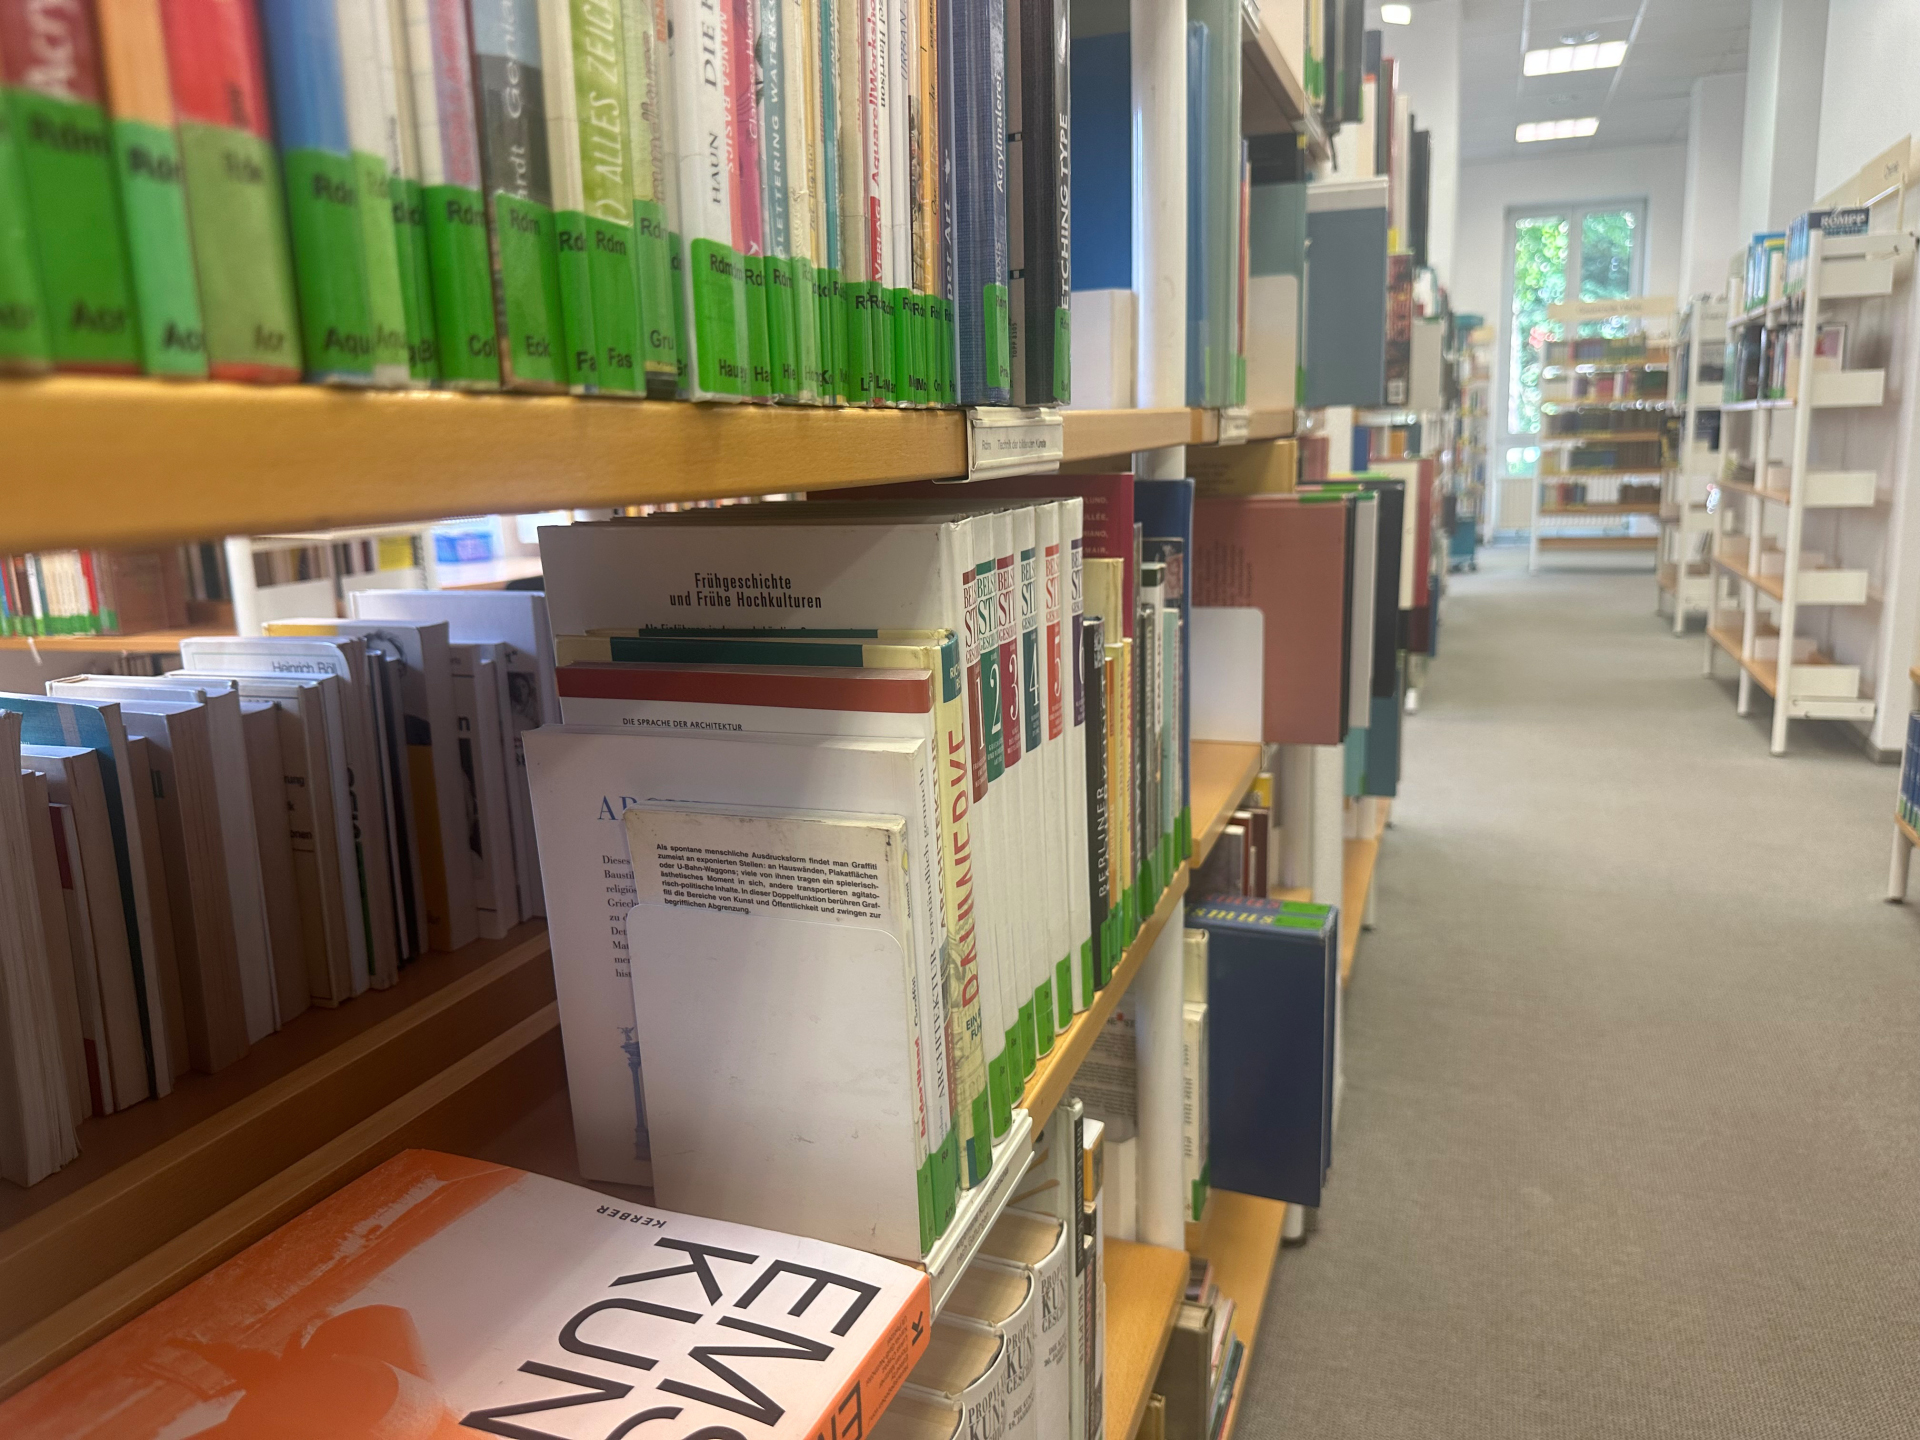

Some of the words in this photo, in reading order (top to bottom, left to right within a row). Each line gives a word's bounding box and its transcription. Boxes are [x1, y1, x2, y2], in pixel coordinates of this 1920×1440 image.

[701, 21, 718, 92] DIE
[720, 10, 730, 87] MANGA
[878, 29, 888, 108] Harrison
[723, 94, 734, 173] BASICS
[992, 69, 1005, 193] Acrylmalerei
[1059, 113, 1069, 180] TYPE
[708, 132, 722, 204] HAUN
[596, 230, 627, 256] Rdm
[873, 205, 882, 280] VERLAG
[607, 347, 633, 369] Fas
[669, 590, 692, 607] und
[696, 590, 732, 607] Frühe
[736, 591, 823, 609] Hochkulturen
[694, 572, 792, 592] Frühgeschichte
[1008, 653, 1020, 721] 3
[1029, 642, 1040, 707] 4
[1054, 635, 1063, 697] 5
[622, 717, 635, 726] DIE
[637, 718, 671, 728] SPRACHE
[673, 720, 688, 729] DER
[689, 721, 743, 731] ARCHITEKTUR
[989, 662, 1002, 735] 2
[919, 767, 929, 838] gemacht
[602, 855, 630, 865] Dieses
[658, 853, 684, 861] zumeist
[696, 857, 737, 867] exponierten
[739, 860, 766, 869] Stellen:
[779, 864, 826, 876] Hauswänden,
[829, 868, 878, 880] Plakatflächen
[670, 845, 702, 854] spontane
[705, 848, 748, 858] menschliche
[752, 852, 806, 863] Ausdrucksform
[809, 857, 830, 866] findet
[851, 861, 877, 870] Graffiti
[1096, 787, 1107, 897] BERLINER
[661, 871, 703, 880] ästhetisches
[707, 875, 734, 883] Moment
[748, 879, 765, 888] sich,
[769, 882, 793, 890] andere
[797, 884, 848, 896] transportieren
[852, 890, 879, 899] agitato-
[662, 880, 714, 891] risch-politische
[715, 886, 739, 894] Inhalte.
[750, 889, 771, 897] dieser
[772, 891, 826, 903] Doppelfunktion
[828, 897, 860, 907] berühren
[862, 900, 880, 908] Graf-
[664, 898, 706, 908] begrifflichen
[708, 903, 751, 914] Abgrenzung.
[677, 864, 739, 876] U-Bahn-Waggons;
[775, 873, 795, 881] ihnen
[797, 876, 821, 884] tragen
[836, 879, 878, 890] spielerisch-
[687, 891, 717, 900] Bereiche
[733, 897, 754, 905] Kunst
[772, 899, 819, 912] Öffentlichkeit
[821, 905, 835, 913] und
[837, 908, 867, 917] zwingen
[923, 843, 936, 945] verständlich
[929, 948, 946, 1099] ARCHITEKTUR
[595, 1204, 668, 1229] KERBER
